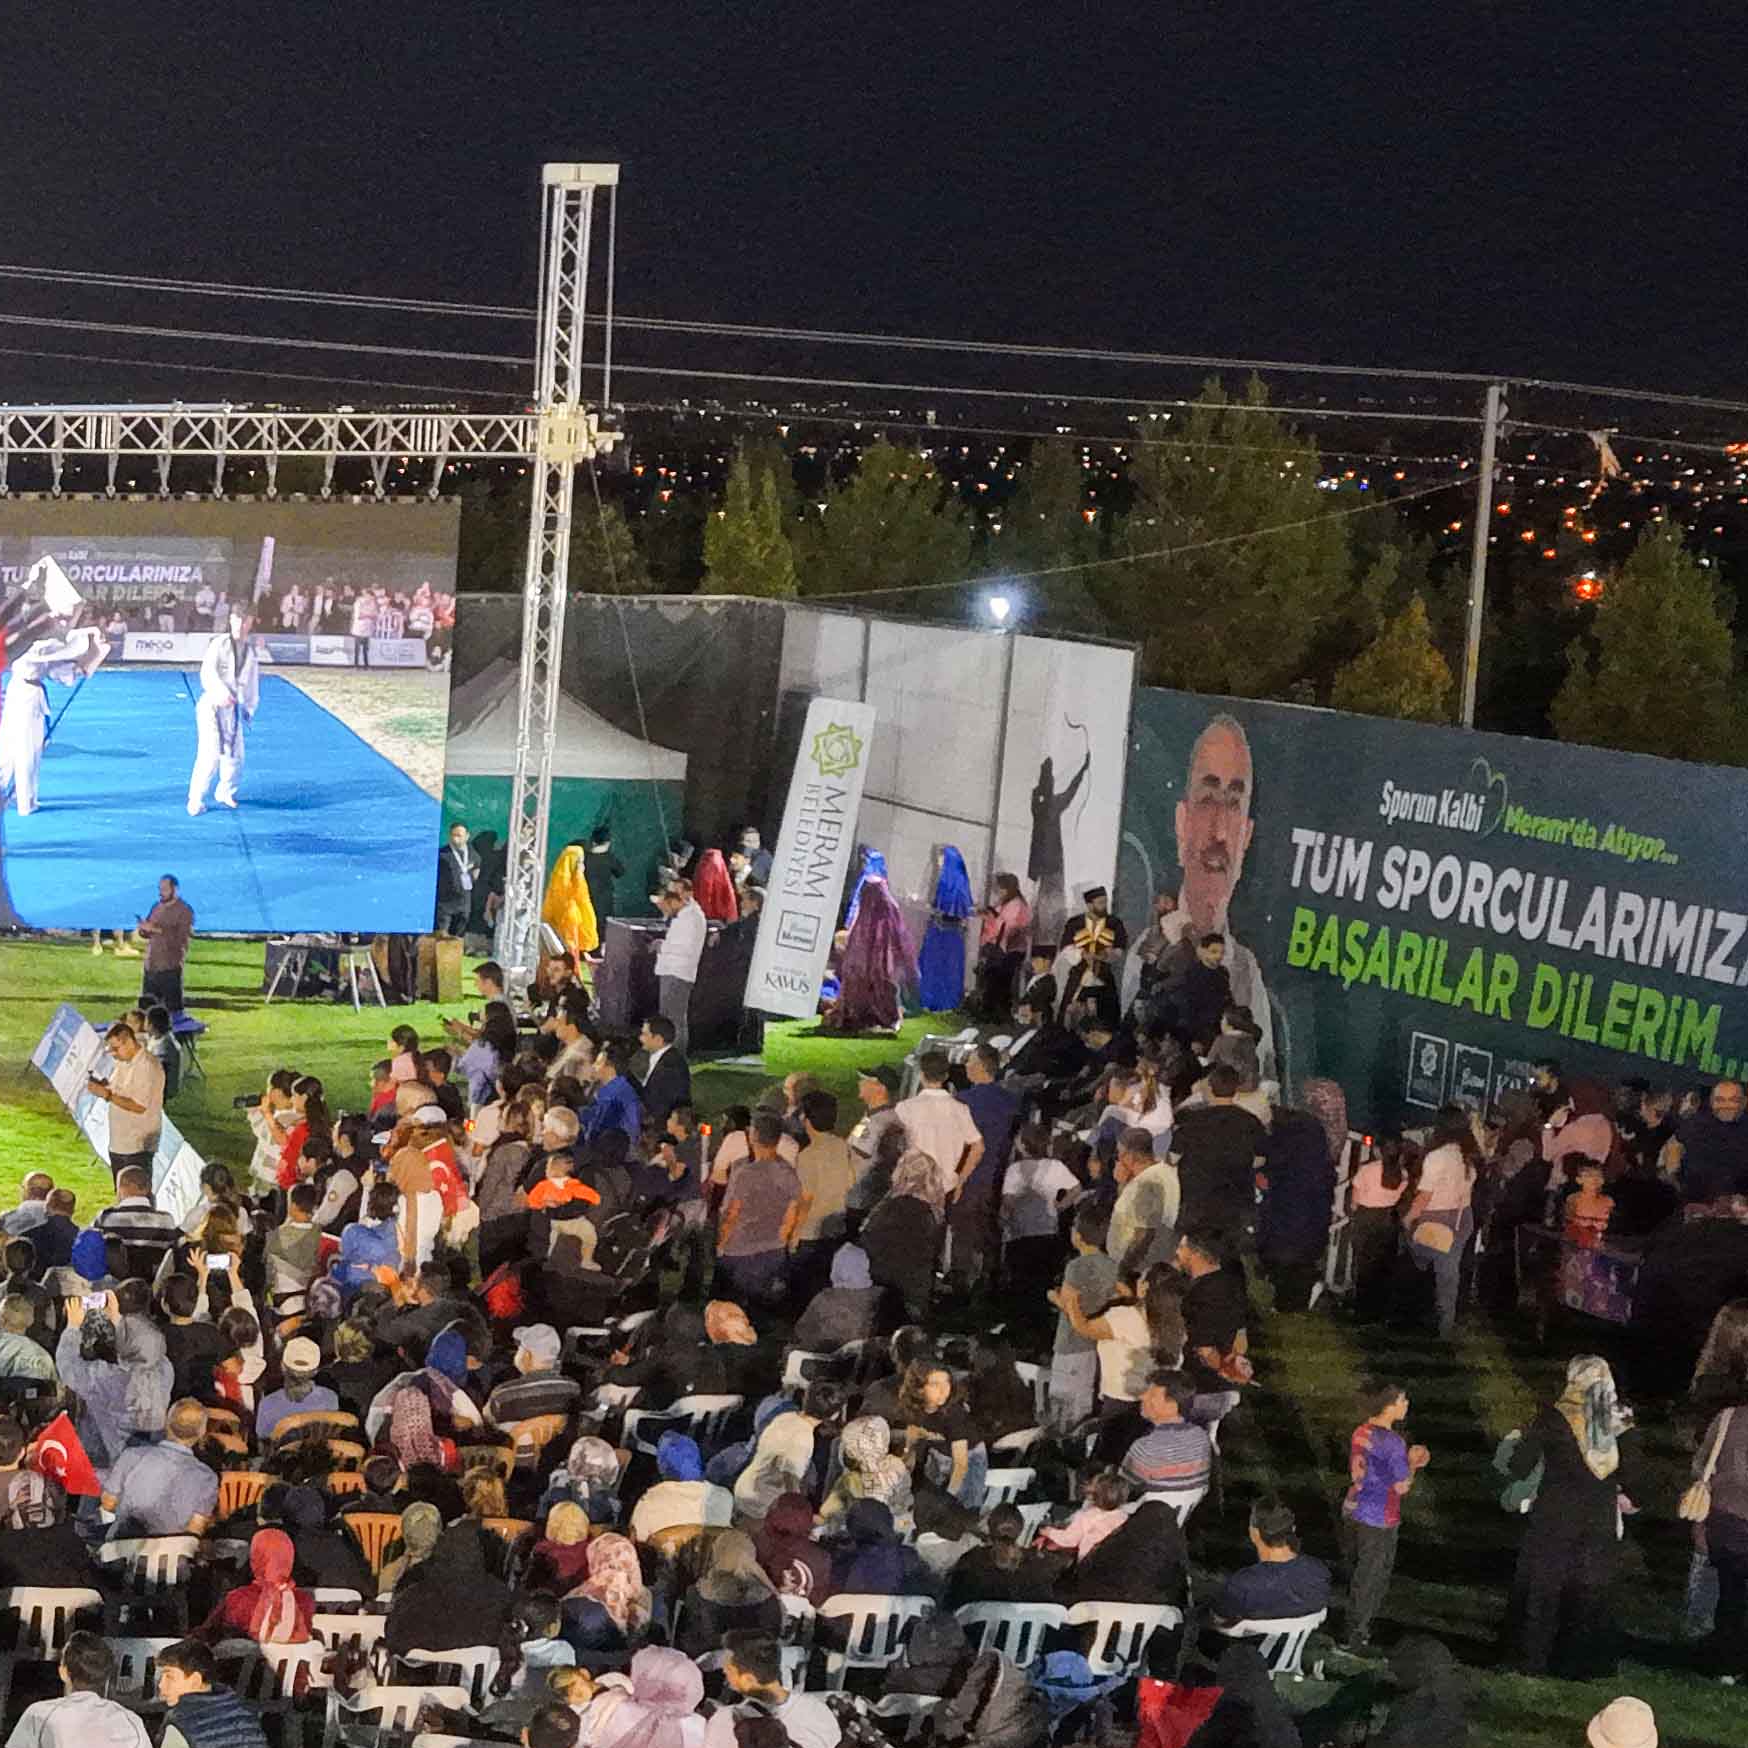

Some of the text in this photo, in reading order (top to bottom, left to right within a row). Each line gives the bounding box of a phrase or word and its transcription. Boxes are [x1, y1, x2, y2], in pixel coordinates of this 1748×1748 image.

[803, 785, 847, 899] MERAM
[1379, 780, 1437, 825] Sporun
[1437, 789, 1486, 832] Kalbi
[1504, 805, 1597, 850] Meram'da
[1287, 906, 1520, 1021] BAŞARILAR
[1290, 828, 1748, 987] TÜM SPORCULARIMIZ
